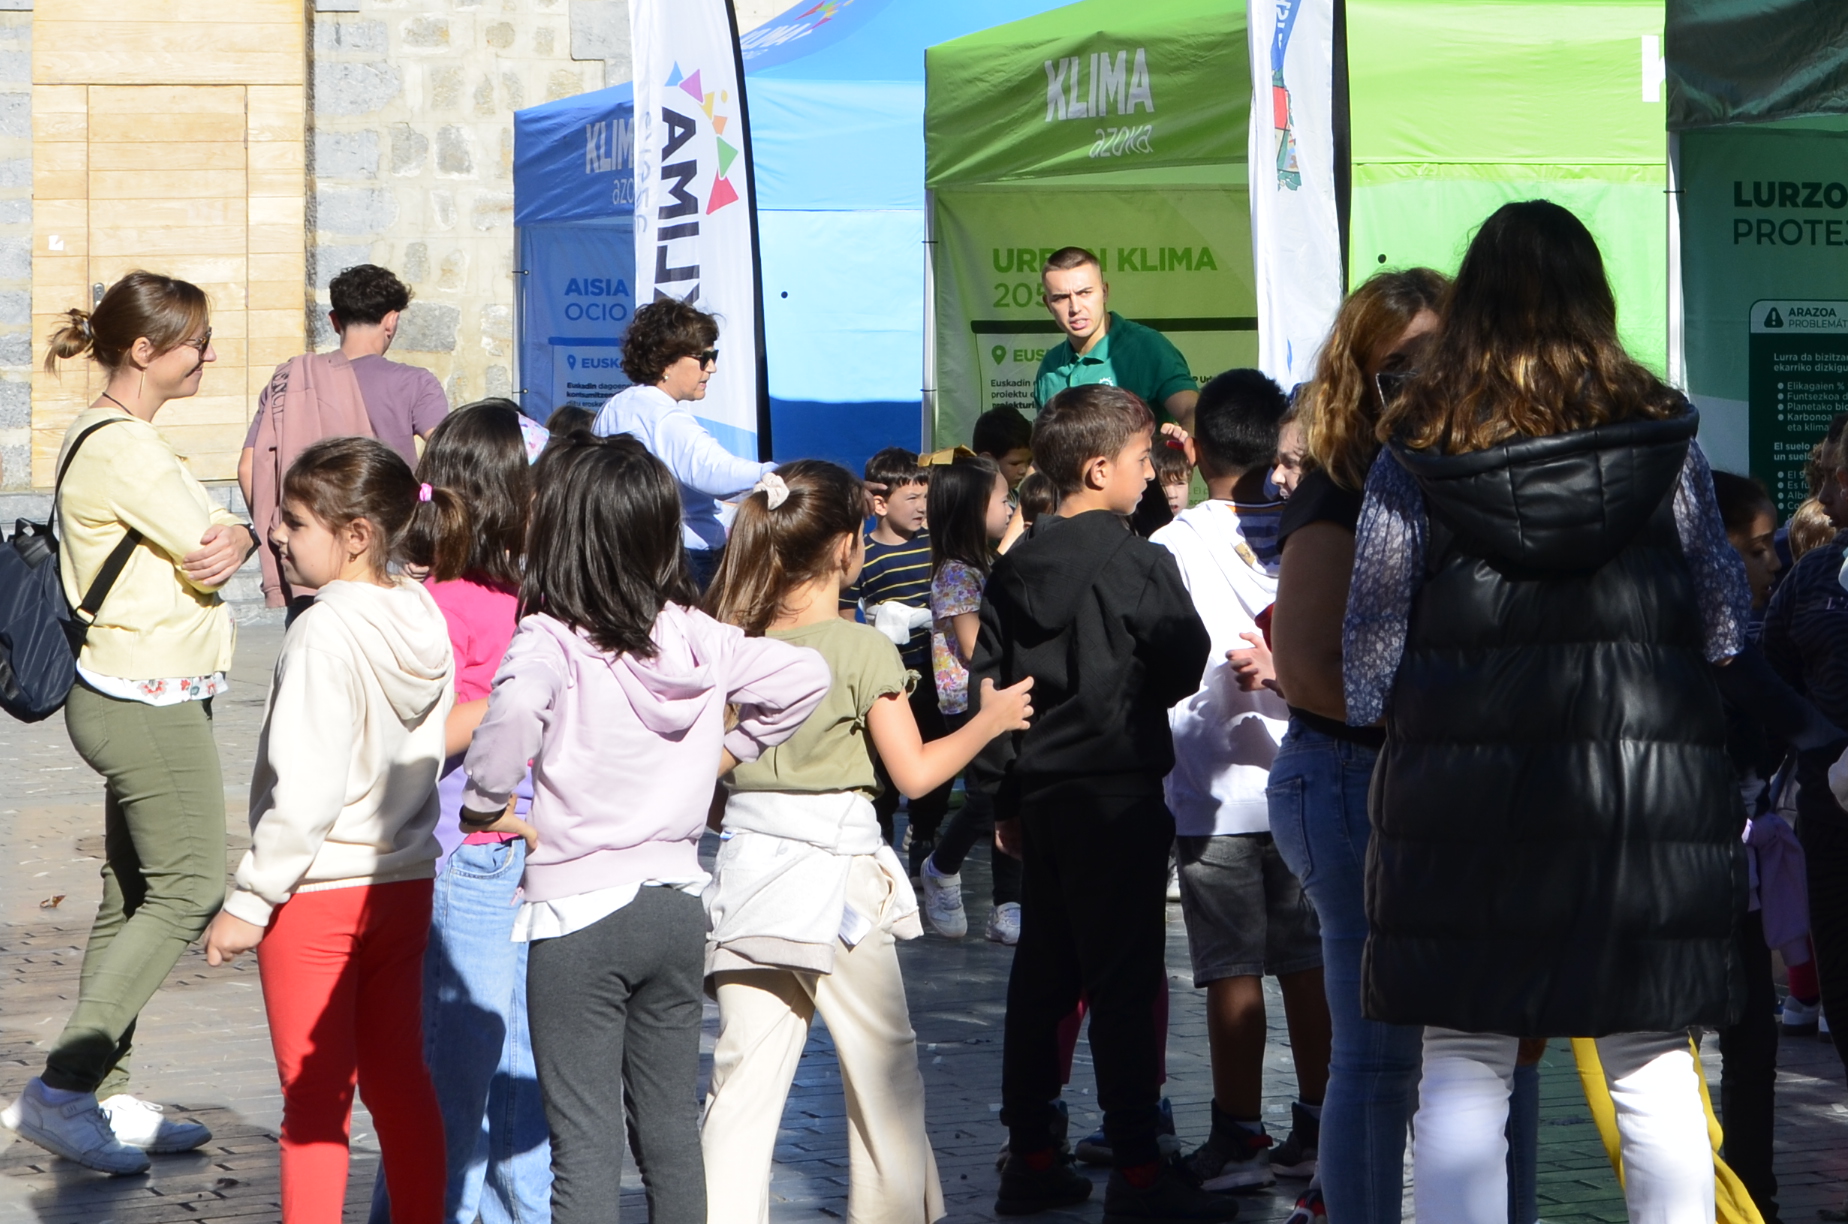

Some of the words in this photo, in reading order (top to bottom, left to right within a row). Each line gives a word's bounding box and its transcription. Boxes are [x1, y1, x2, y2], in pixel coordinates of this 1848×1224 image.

[1044, 47, 1155, 122] KLIMA
[585, 117, 635, 174] KLIM
[611, 179, 635, 205] azo
[1118, 247, 1218, 273] KLIMA
[564, 278, 630, 296] AISIA
[565, 303, 628, 321] OCIO
[1788, 307, 1837, 318] ARAZOA
[1774, 353, 1798, 362] Lurra
[1801, 353, 1812, 362] da
[581, 358, 623, 369] EUSK
[1774, 363, 1812, 372] ekarriko
[990, 379, 1031, 387] Euskadin
[1787, 382, 1834, 392] Elikagaien
[1837, 382, 1845, 391] %
[991, 390, 1028, 399] proiektu
[1787, 392, 1839, 401] Funtsezkoa
[1787, 402, 1831, 411] Planetako
[1787, 424, 1801, 432] eta
[1774, 442, 1783, 451] El
[1785, 442, 1810, 451] suelo
